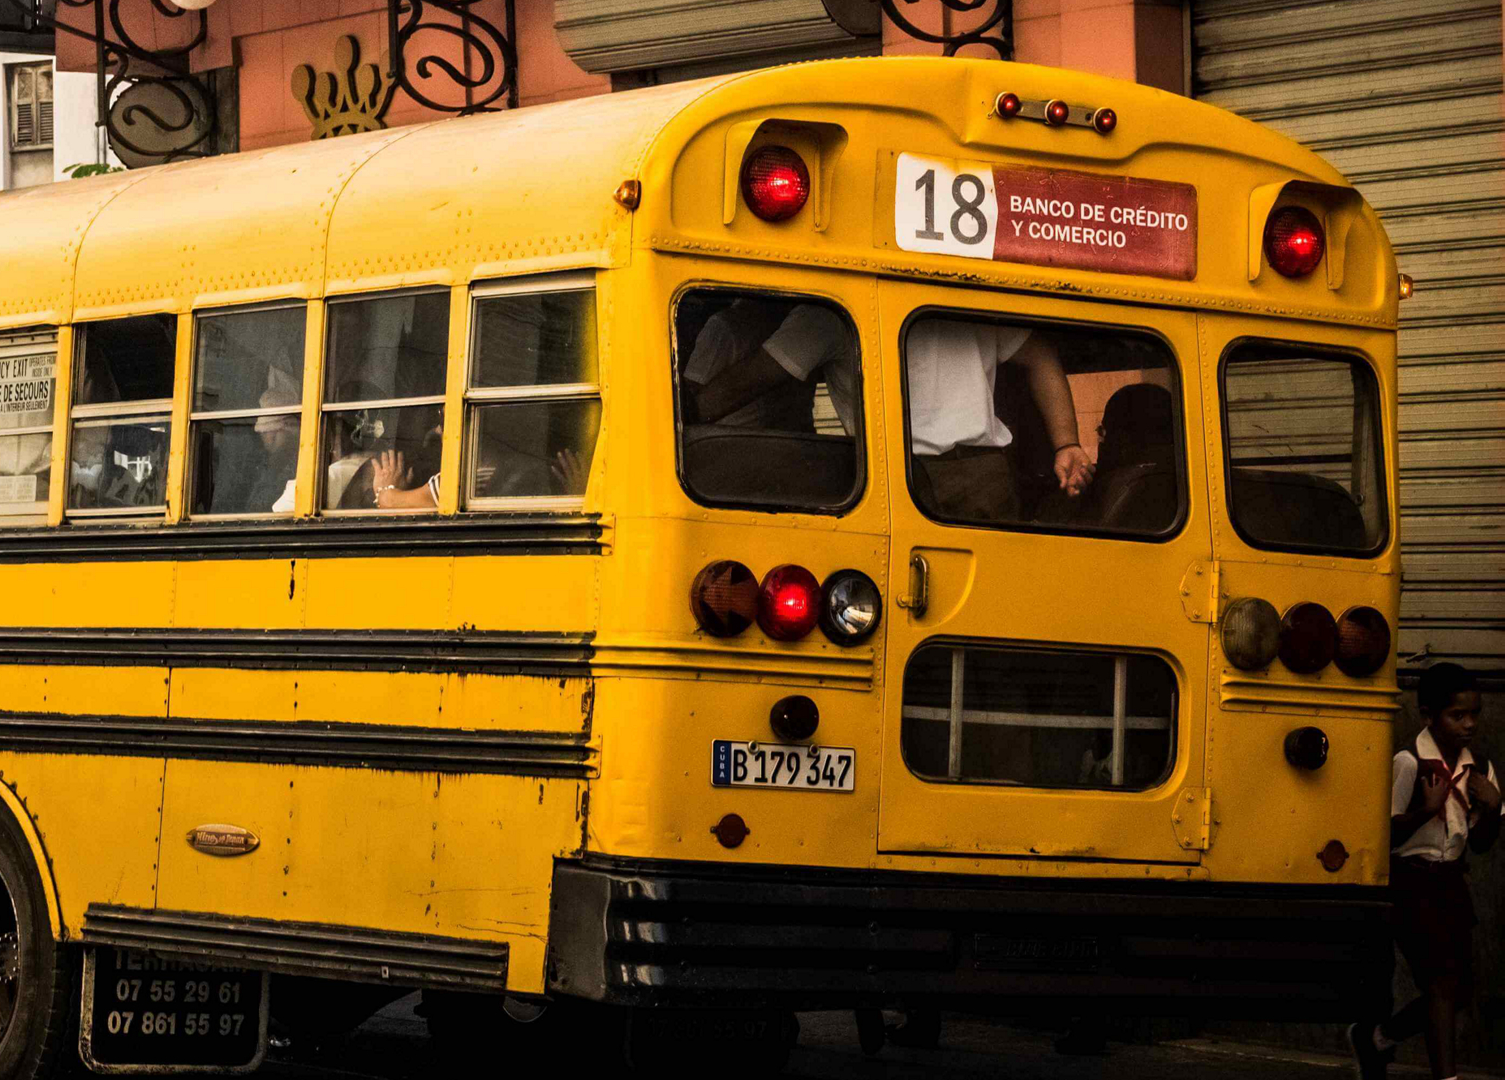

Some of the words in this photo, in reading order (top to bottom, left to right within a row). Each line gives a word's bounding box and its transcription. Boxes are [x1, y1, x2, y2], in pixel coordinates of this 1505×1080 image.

[915, 169, 988, 245] 18
[1010, 195, 1075, 219] BANCO
[1080, 202, 1106, 222] DE
[1110, 206, 1188, 231] CRÉDITO
[1011, 220, 1023, 236] Y
[1028, 221, 1127, 248] COMERCIO
[13, 358, 28, 377] EXIT
[3, 383, 13, 402] DE
[14, 380, 49, 401] SECOURS
[116, 978, 142, 1001] 07
[150, 980, 176, 1002] 55
[184, 981, 210, 1003] 29
[218, 982, 241, 1003] 61
[107, 1011, 134, 1034] 07
[141, 1012, 176, 1035] 861
[184, 1013, 210, 1036] 55
[219, 1014, 245, 1036] 97
